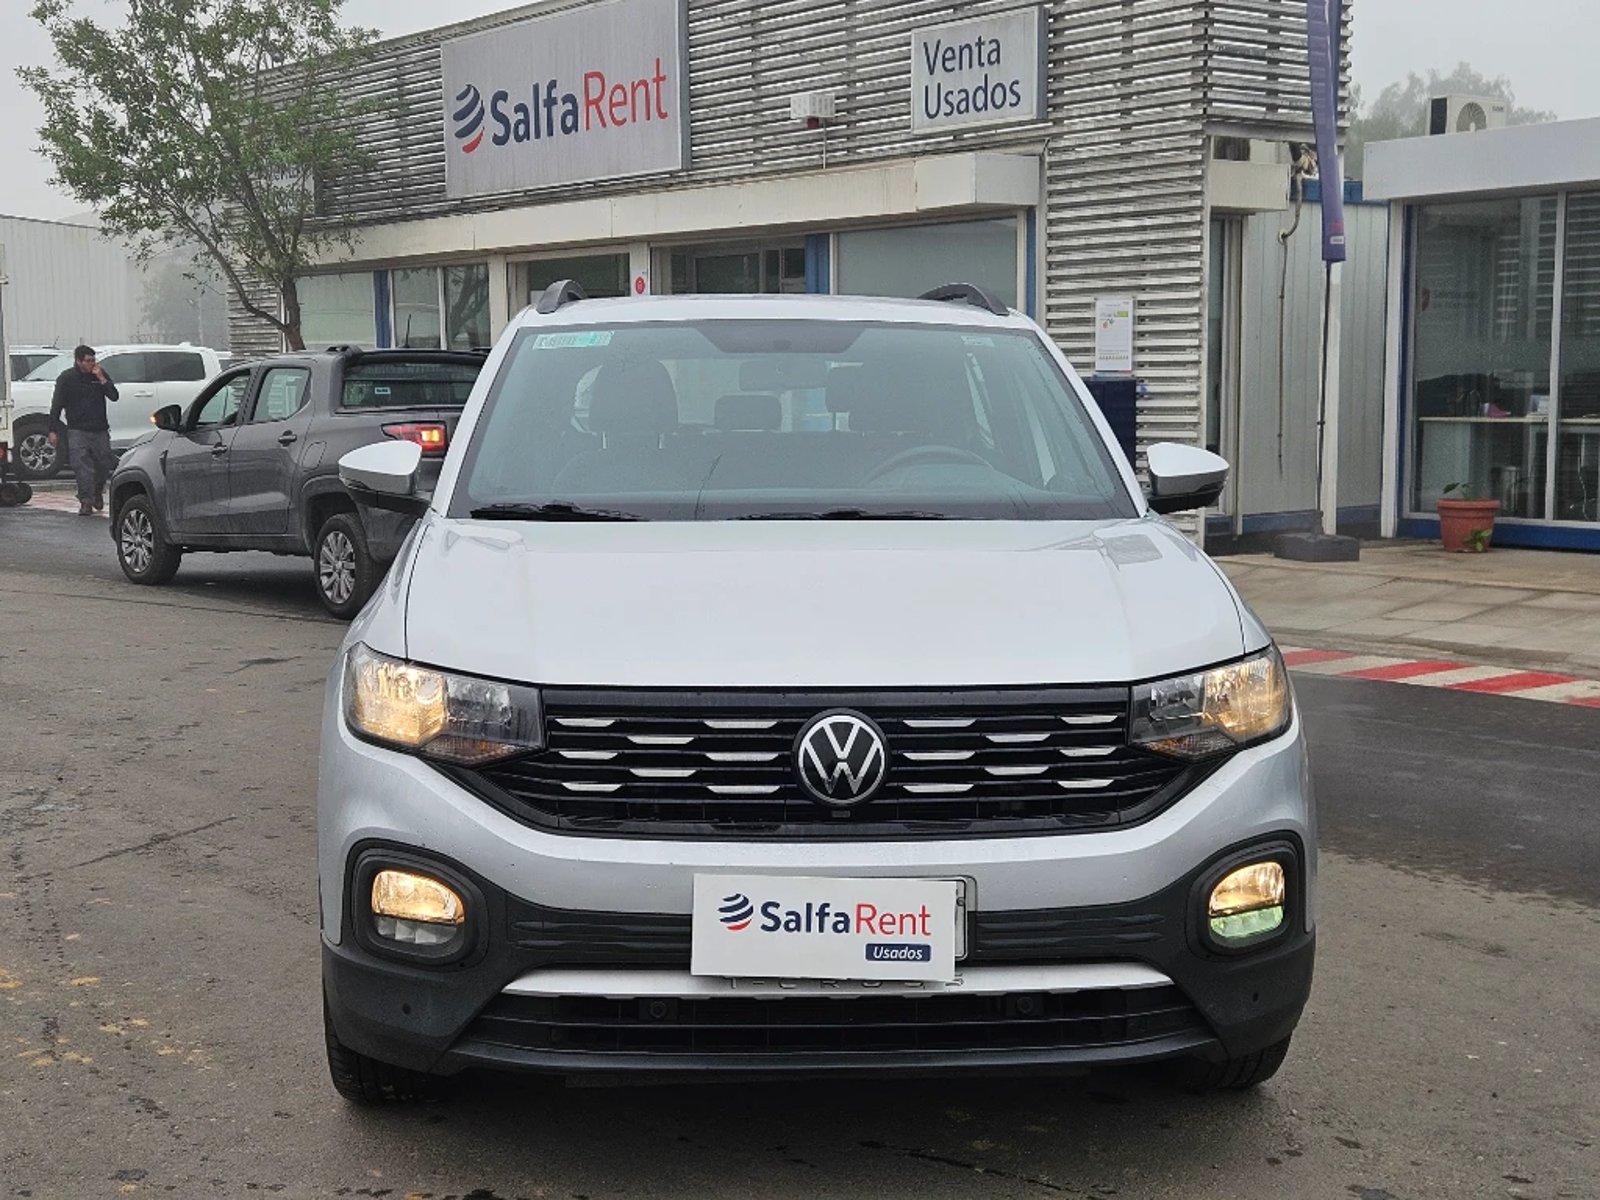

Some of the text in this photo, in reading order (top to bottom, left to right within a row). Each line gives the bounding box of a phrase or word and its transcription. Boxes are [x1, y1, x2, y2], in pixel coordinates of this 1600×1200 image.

[923, 35, 1001, 75] Venta
[490, 57, 668, 146] SalfaRent
[924, 73, 1021, 119] Usados
[760, 900, 932, 936] SalfaRent
[873, 946, 923, 960] Usados
